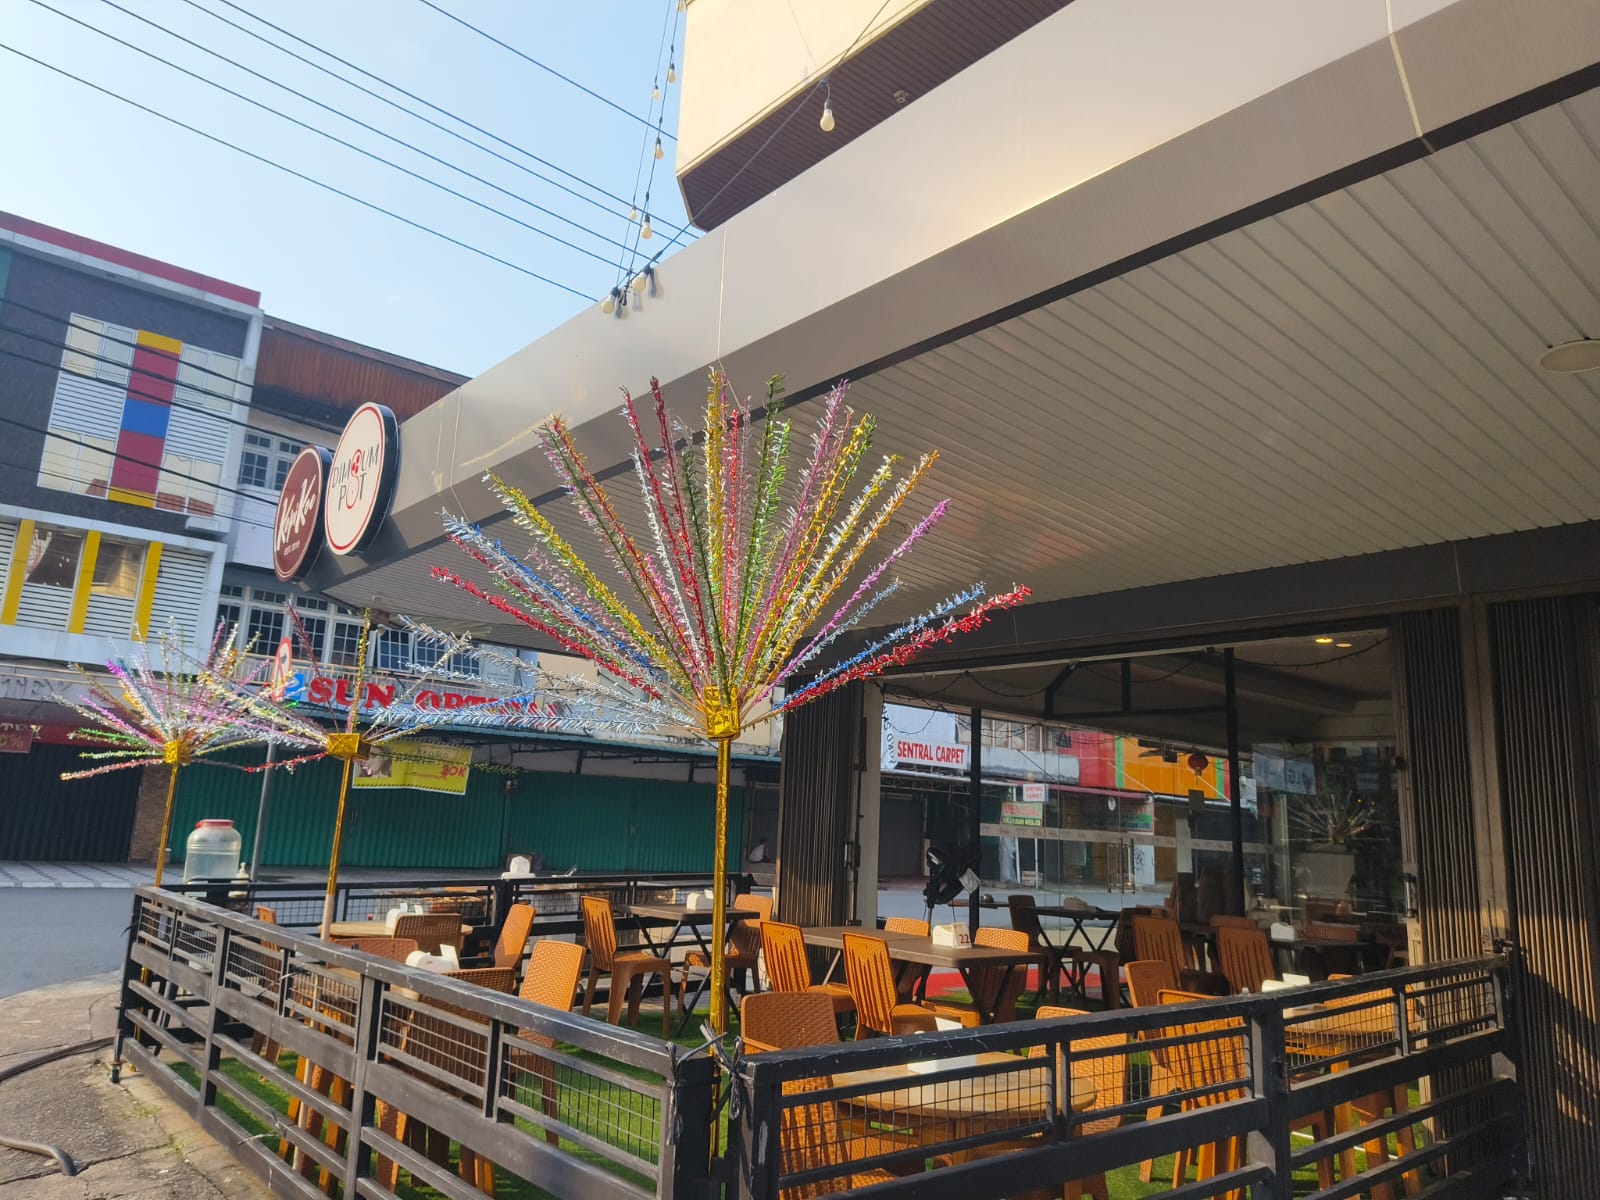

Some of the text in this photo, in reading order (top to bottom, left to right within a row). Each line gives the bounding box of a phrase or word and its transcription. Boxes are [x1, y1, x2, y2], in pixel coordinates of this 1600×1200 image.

[308, 677, 396, 709] SUN
[897, 740, 965, 764] SENTRAL CARPET
[959, 934, 970, 944] 22
